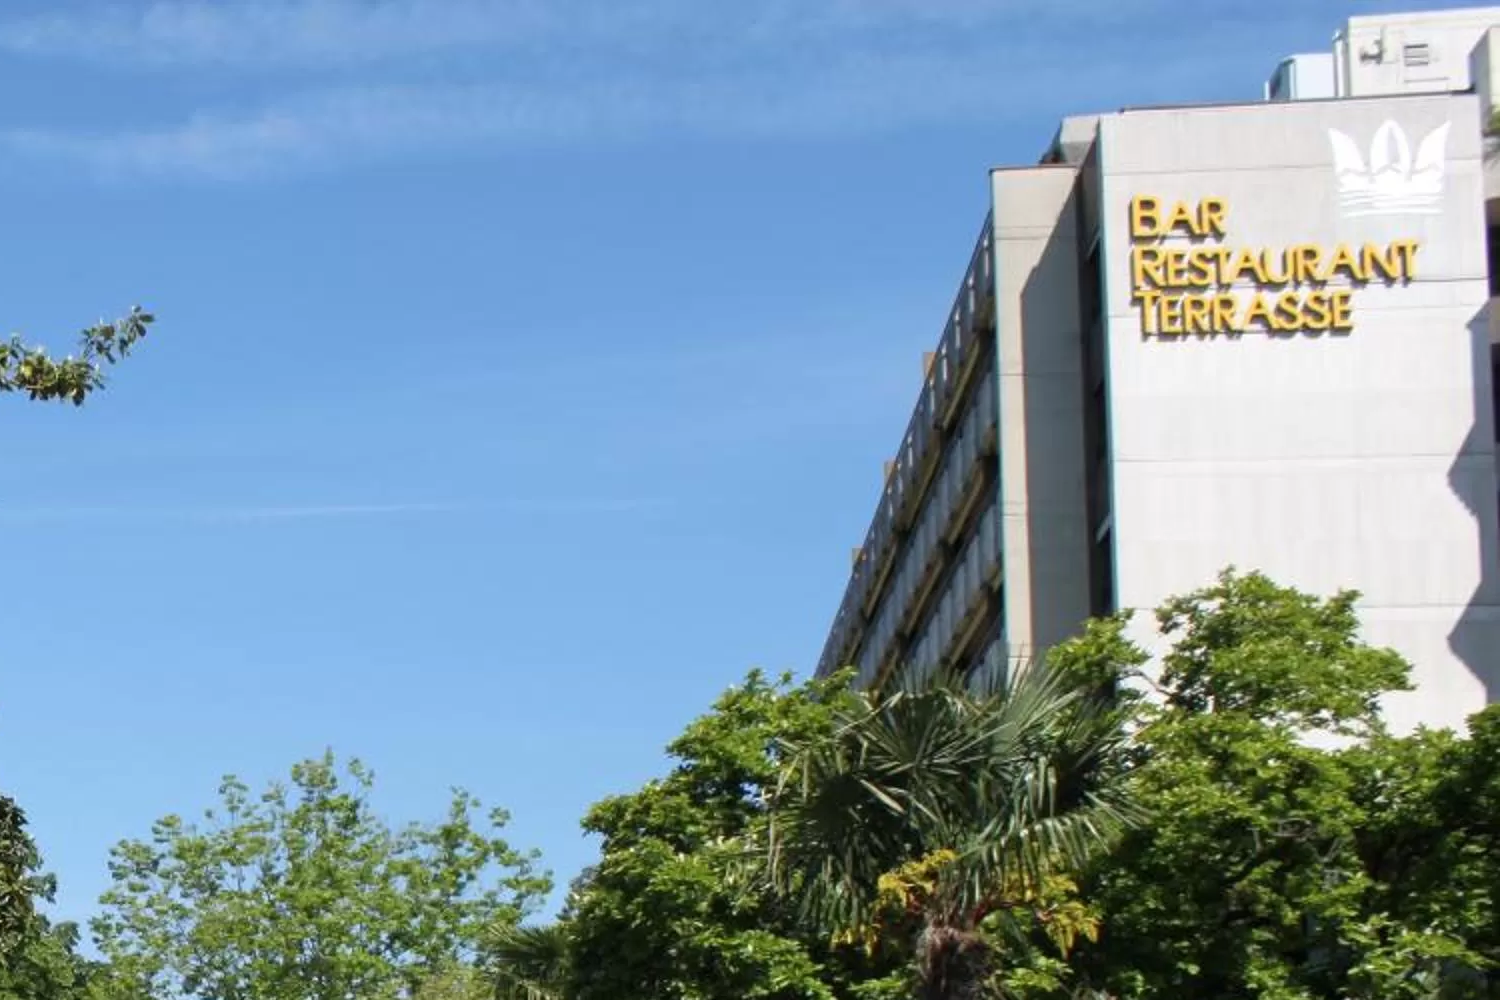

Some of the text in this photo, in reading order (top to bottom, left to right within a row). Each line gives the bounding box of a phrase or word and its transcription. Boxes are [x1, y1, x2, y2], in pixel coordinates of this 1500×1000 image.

[1132, 195, 1227, 238] BAR
[1133, 239, 1420, 287] RESTAURANT
[1134, 289, 1355, 333] TERRASSE
